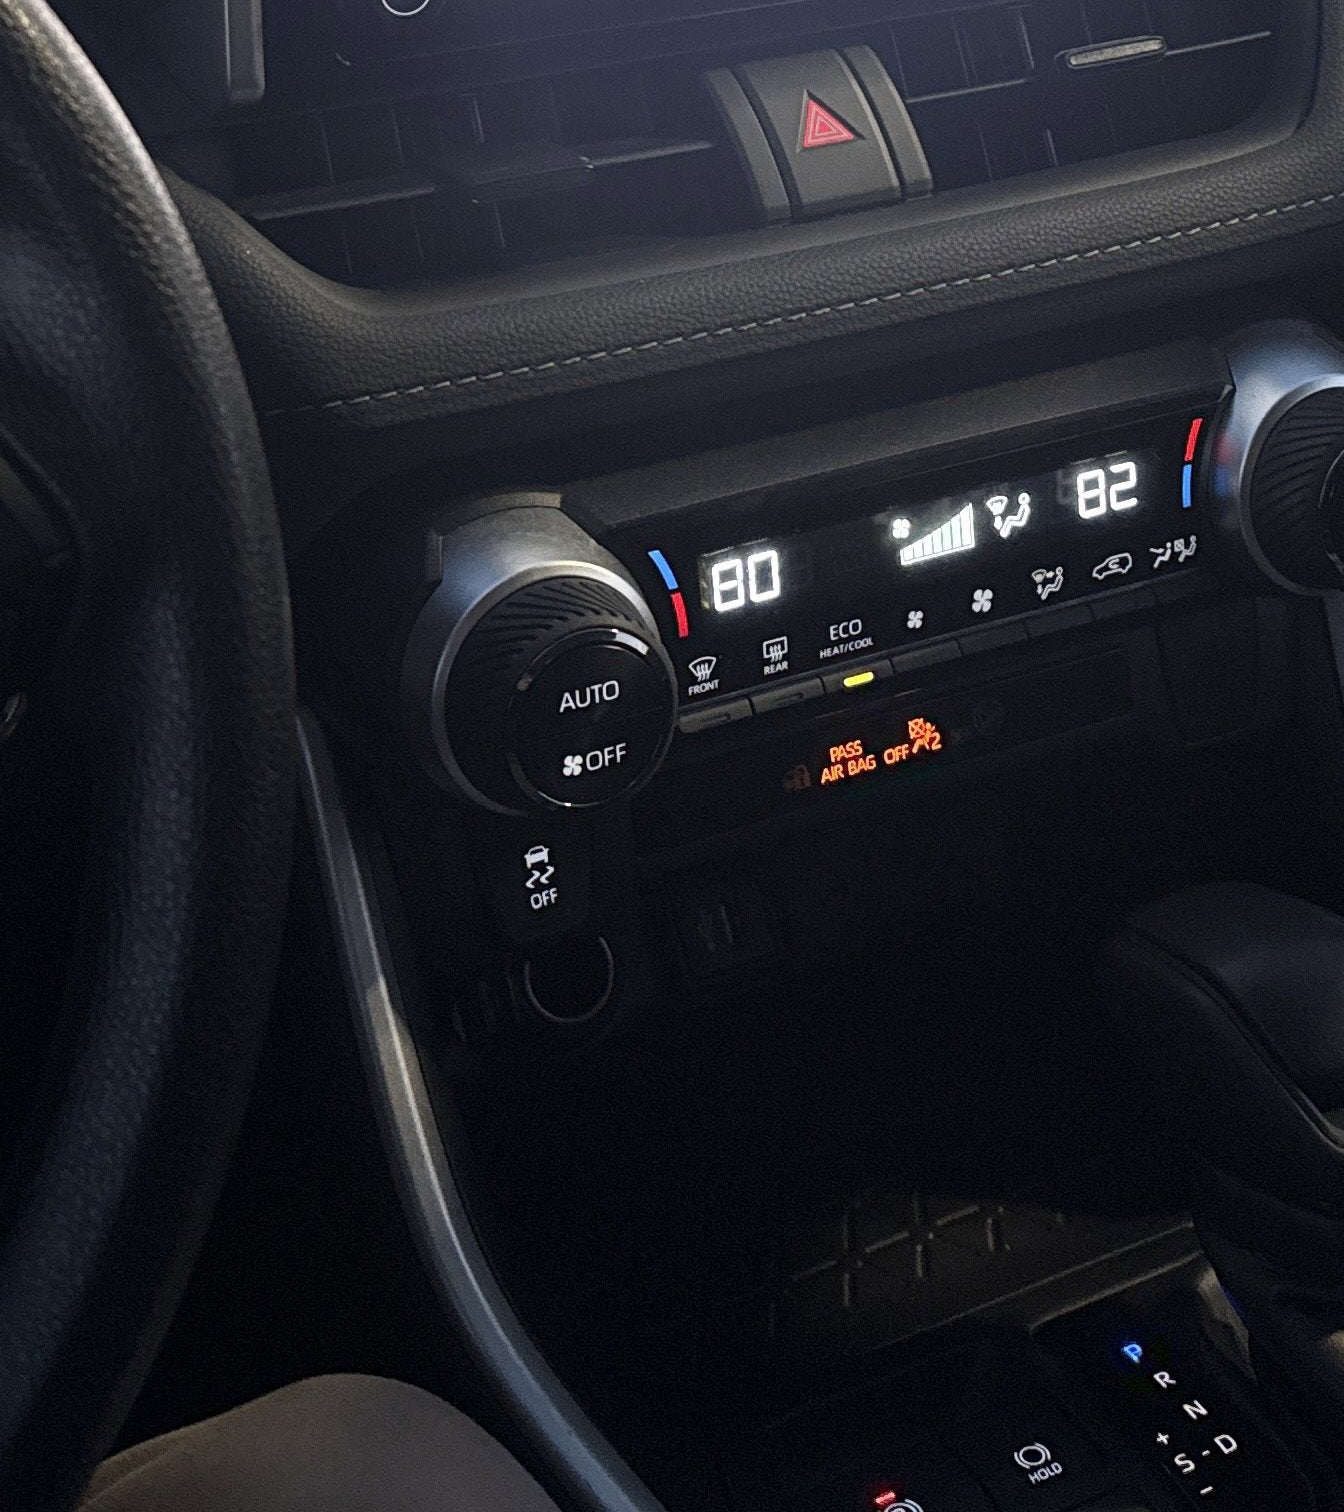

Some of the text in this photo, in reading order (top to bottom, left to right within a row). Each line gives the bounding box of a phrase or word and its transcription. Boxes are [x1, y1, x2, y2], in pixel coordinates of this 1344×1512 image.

[1076, 461, 1138, 519] 82
[712, 549, 781, 613] 80
[829, 619, 863, 640] ECO
[819, 637, 874, 660] HEAT/COOL
[763, 661, 789, 675] REAR
[559, 680, 620, 712] AUTO
[687, 679, 720, 696] FRONT
[585, 743, 627, 771] OFF
[829, 740, 863, 763] PASS
[821, 743, 910, 785] AIR BAG OFF
[530, 888, 558, 910] OFF
[1122, 1343, 1144, 1364] P
[1153, 1371, 1176, 1389] R
[1182, 1399, 1208, 1420] N
[1213, 1434, 1238, 1454] D
[1028, 1462, 1063, 1485] HOLD
